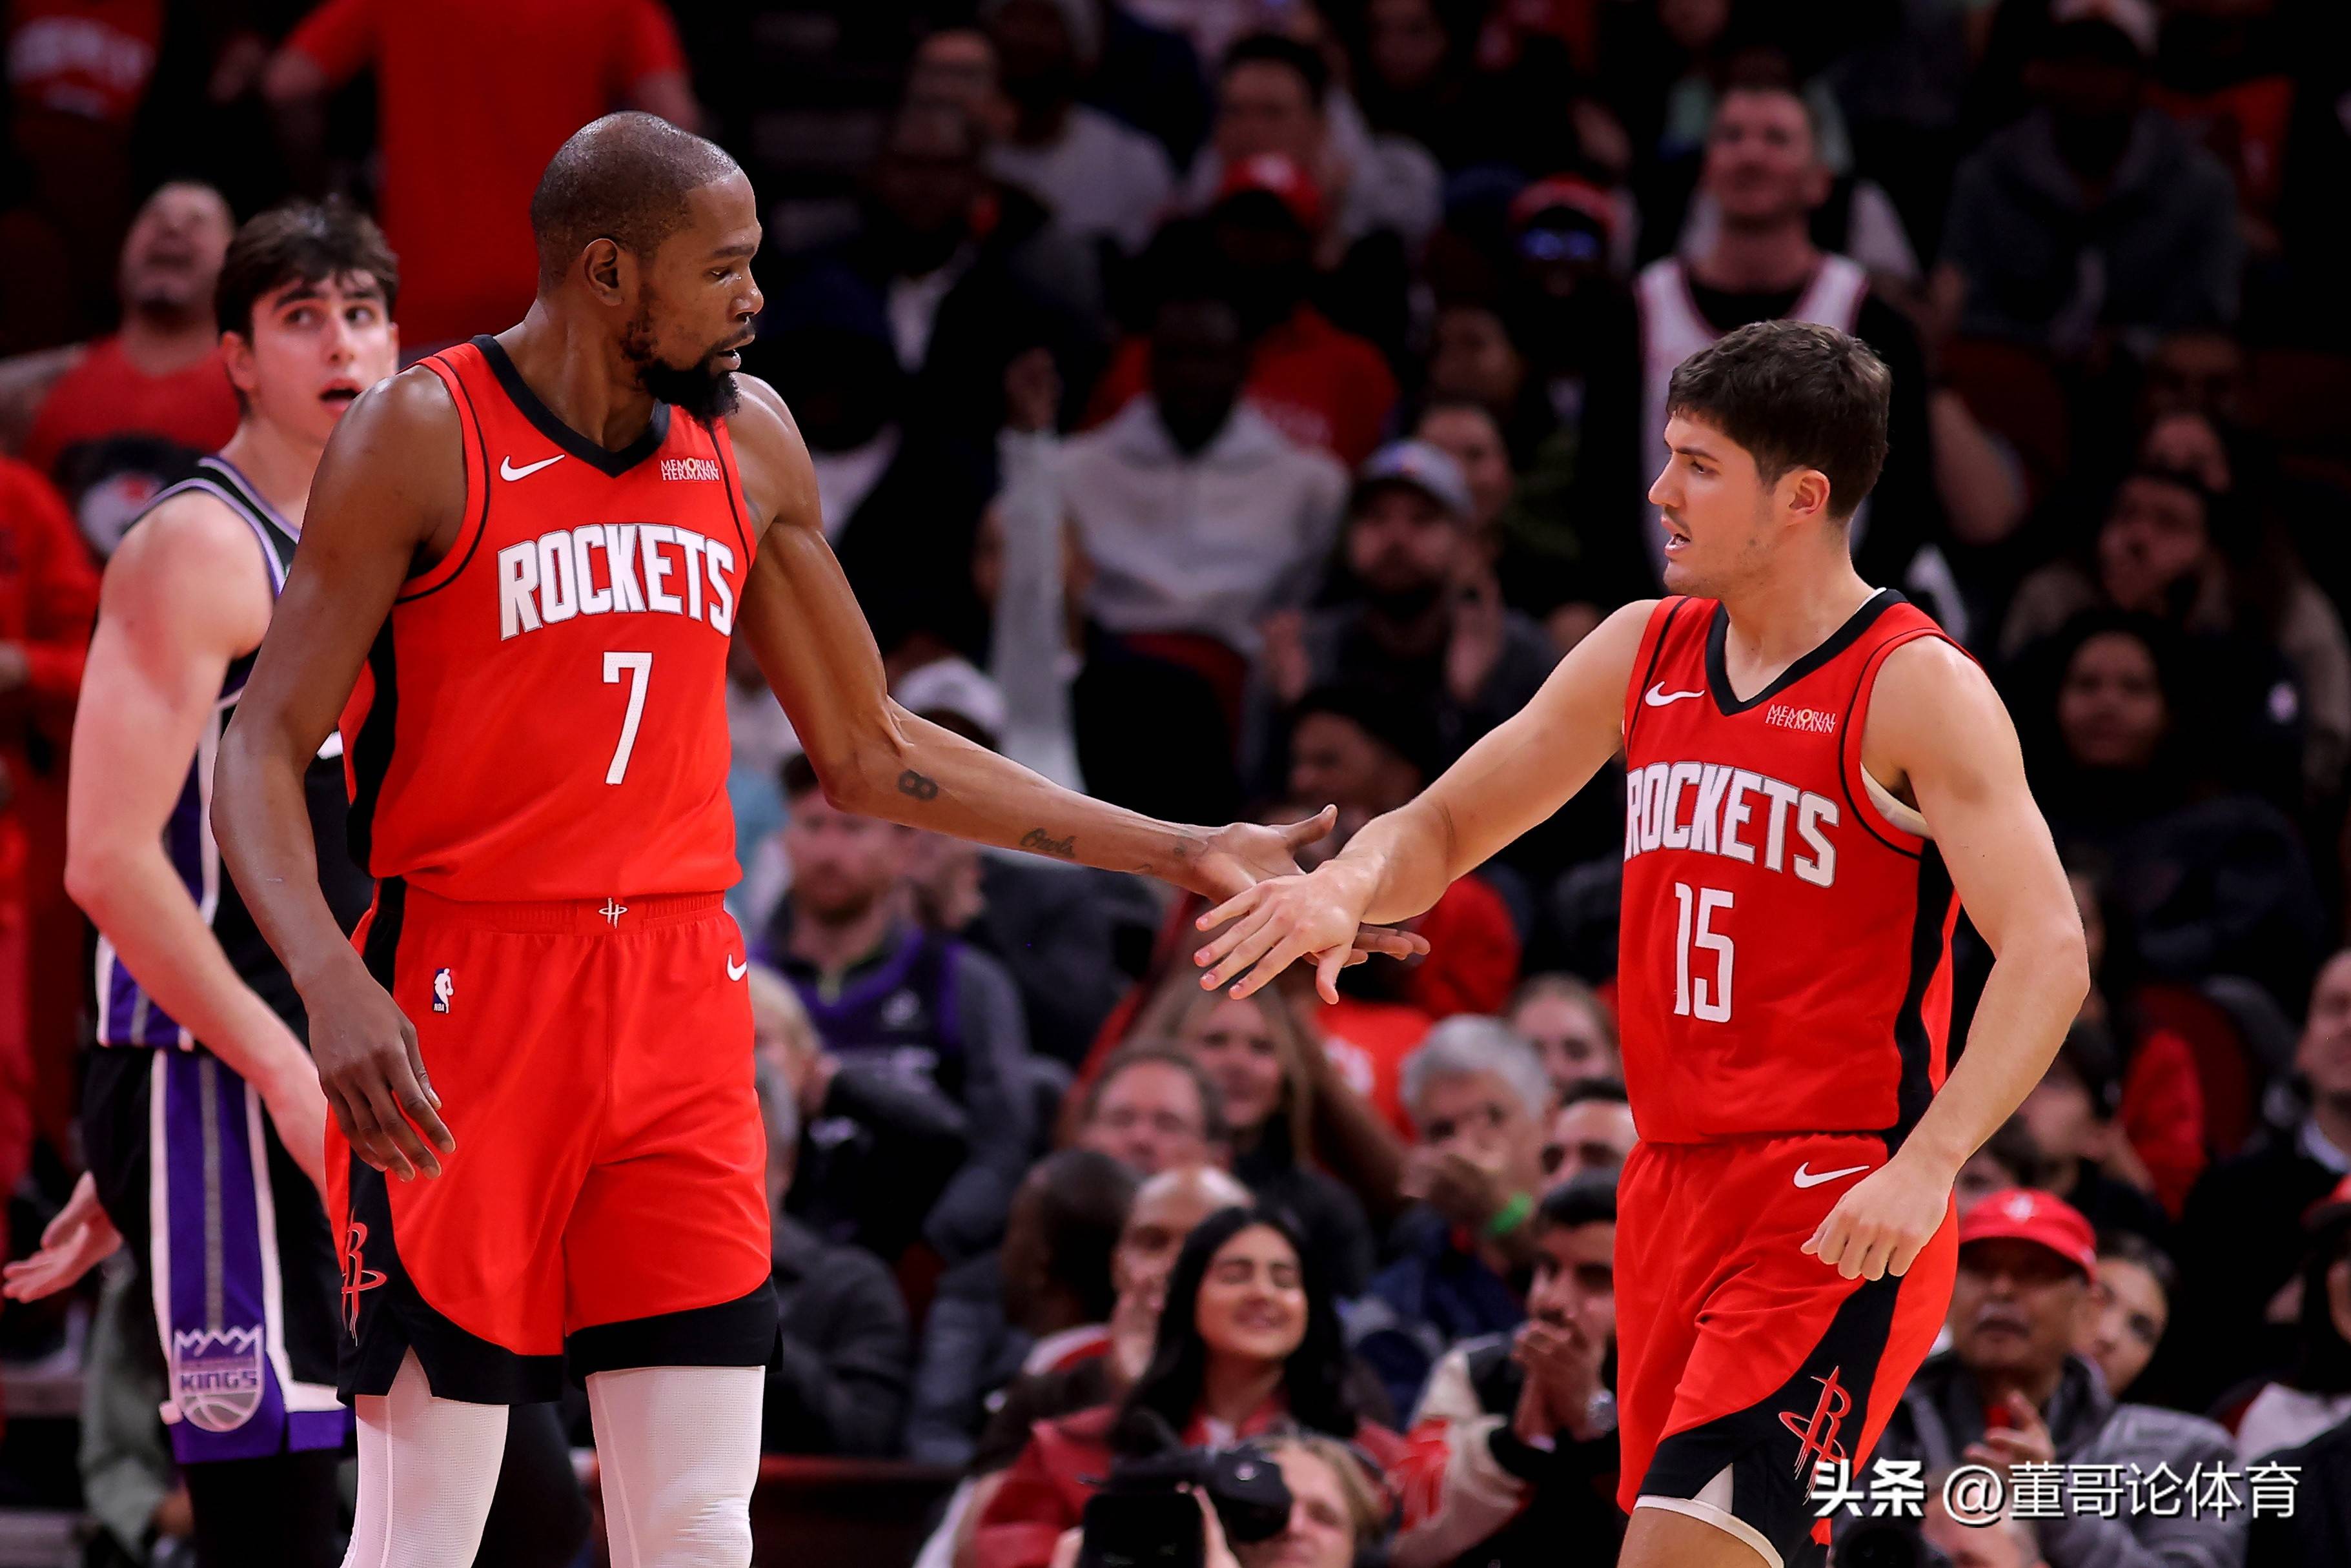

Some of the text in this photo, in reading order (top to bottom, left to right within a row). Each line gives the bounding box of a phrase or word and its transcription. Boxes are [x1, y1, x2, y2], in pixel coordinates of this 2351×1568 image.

[660, 457, 718, 471] MEMORIAL
[662, 469, 720, 481] HERMANN
[497, 522, 735, 641] ROCKETS
[603, 651, 653, 785] 7
[1765, 712, 1836, 733] HERMANN
[1767, 704, 1836, 724] MEMORIAL
[898, 769, 939, 800] 8
[1624, 760, 1840, 888] ROCKETS
[1673, 882, 1735, 1024] 15
[433, 1003, 445, 1012] NBA
[180, 1370, 257, 1390] KINGS
